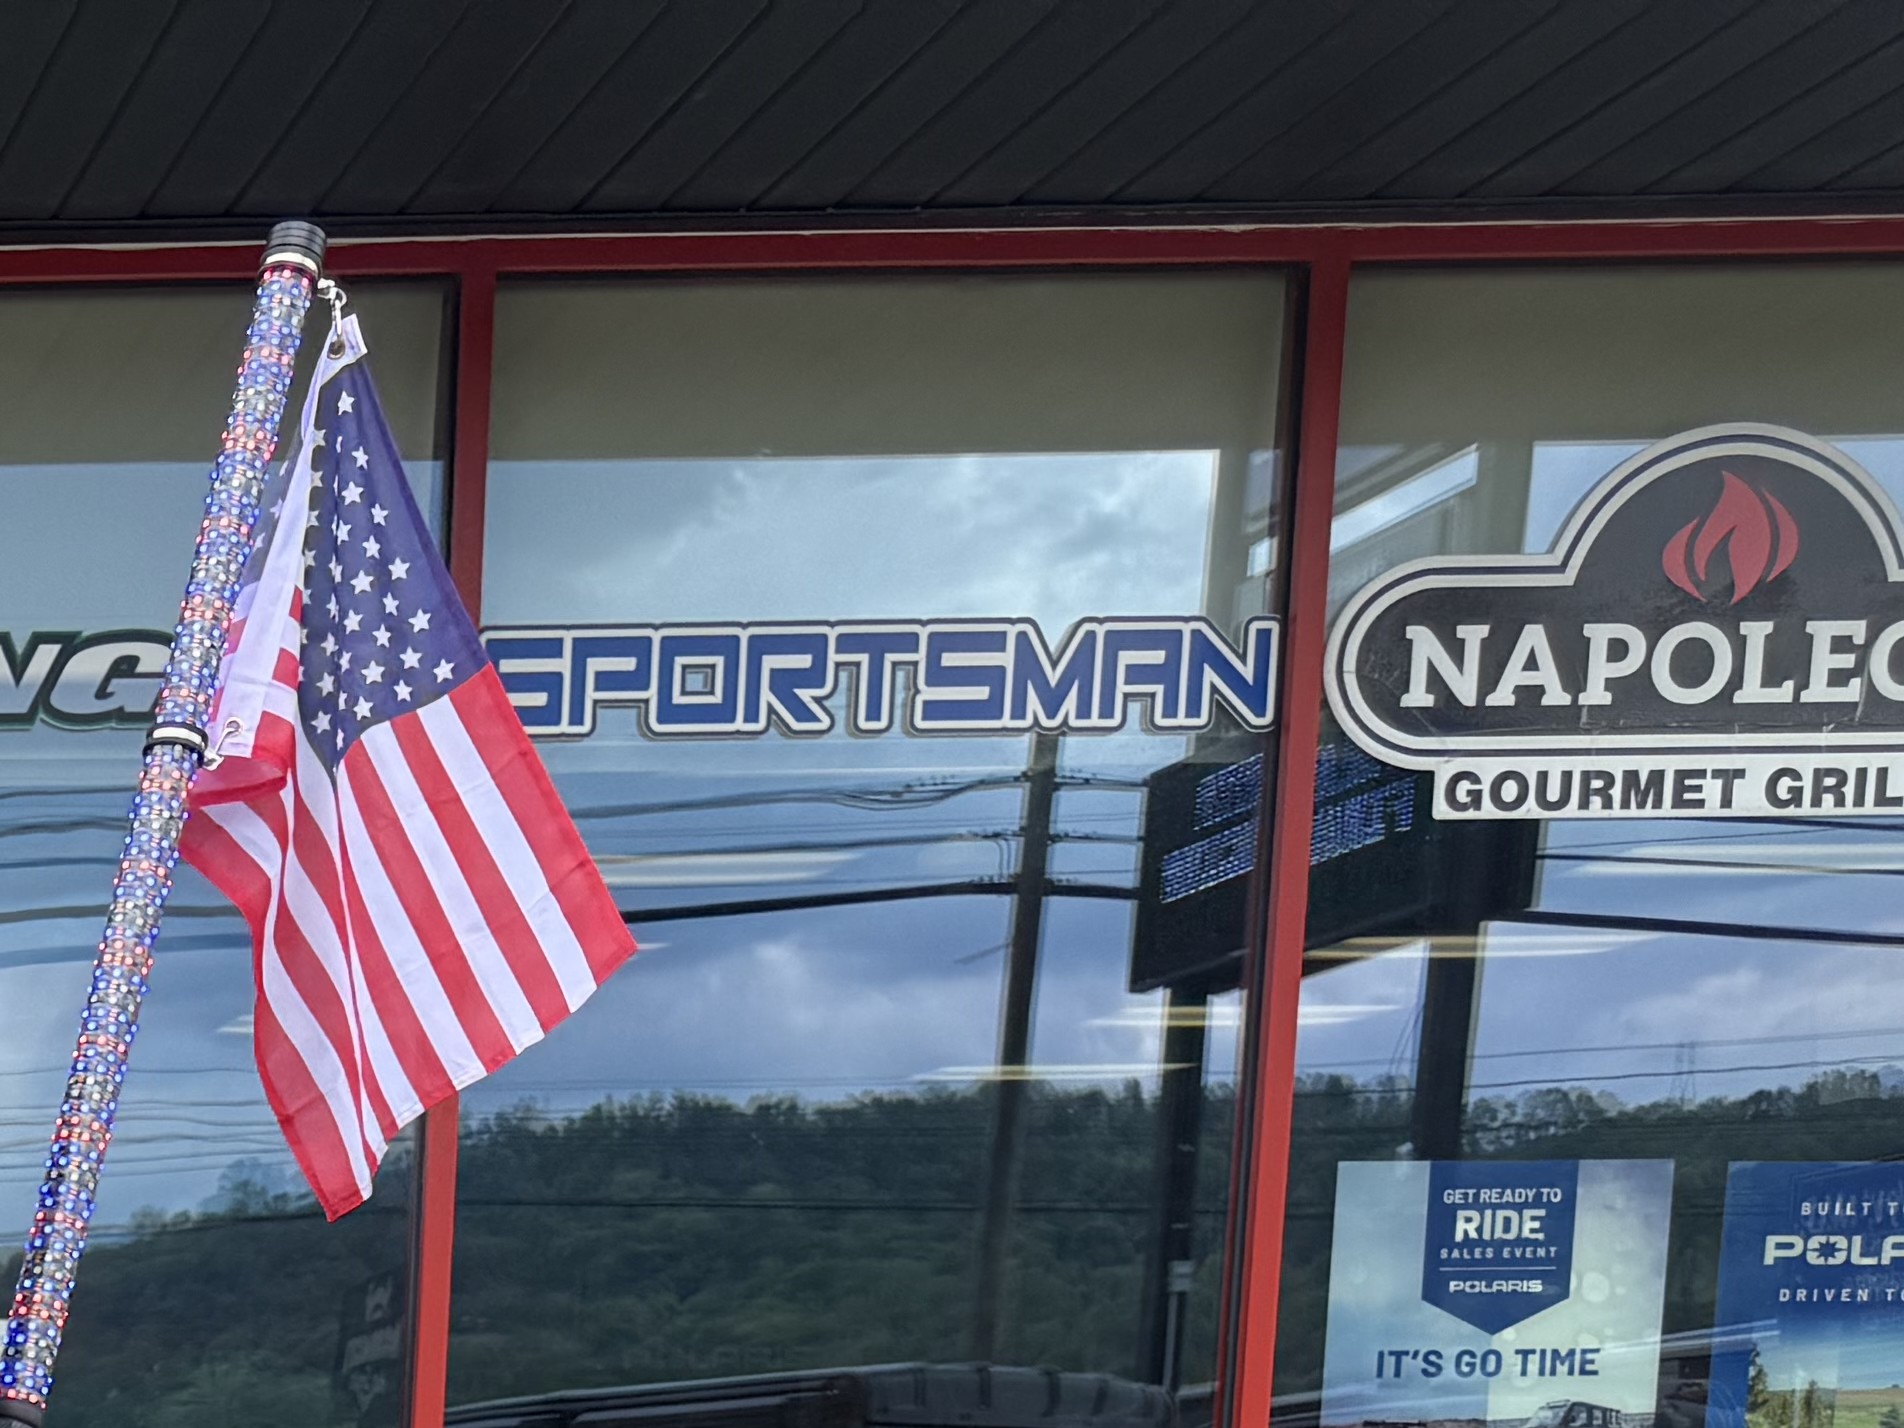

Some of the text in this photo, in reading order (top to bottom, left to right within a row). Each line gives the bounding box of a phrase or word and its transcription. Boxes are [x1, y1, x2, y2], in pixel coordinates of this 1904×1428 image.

[482, 616, 1280, 739] SPORTSMAN
[1444, 766, 1904, 812] GOURMET GRIL
[1443, 1187, 1562, 1204] GET READY TO
[1800, 1202, 1904, 1217] BUILT T
[1454, 1208, 1547, 1243] RIDE
[1440, 1247, 1557, 1260] SALES EVENT
[1449, 1280, 1543, 1294] POLARIS
[1779, 1288, 1904, 1303] DRIVEN T
[1375, 1347, 1602, 1380] IT'S GO TIME
